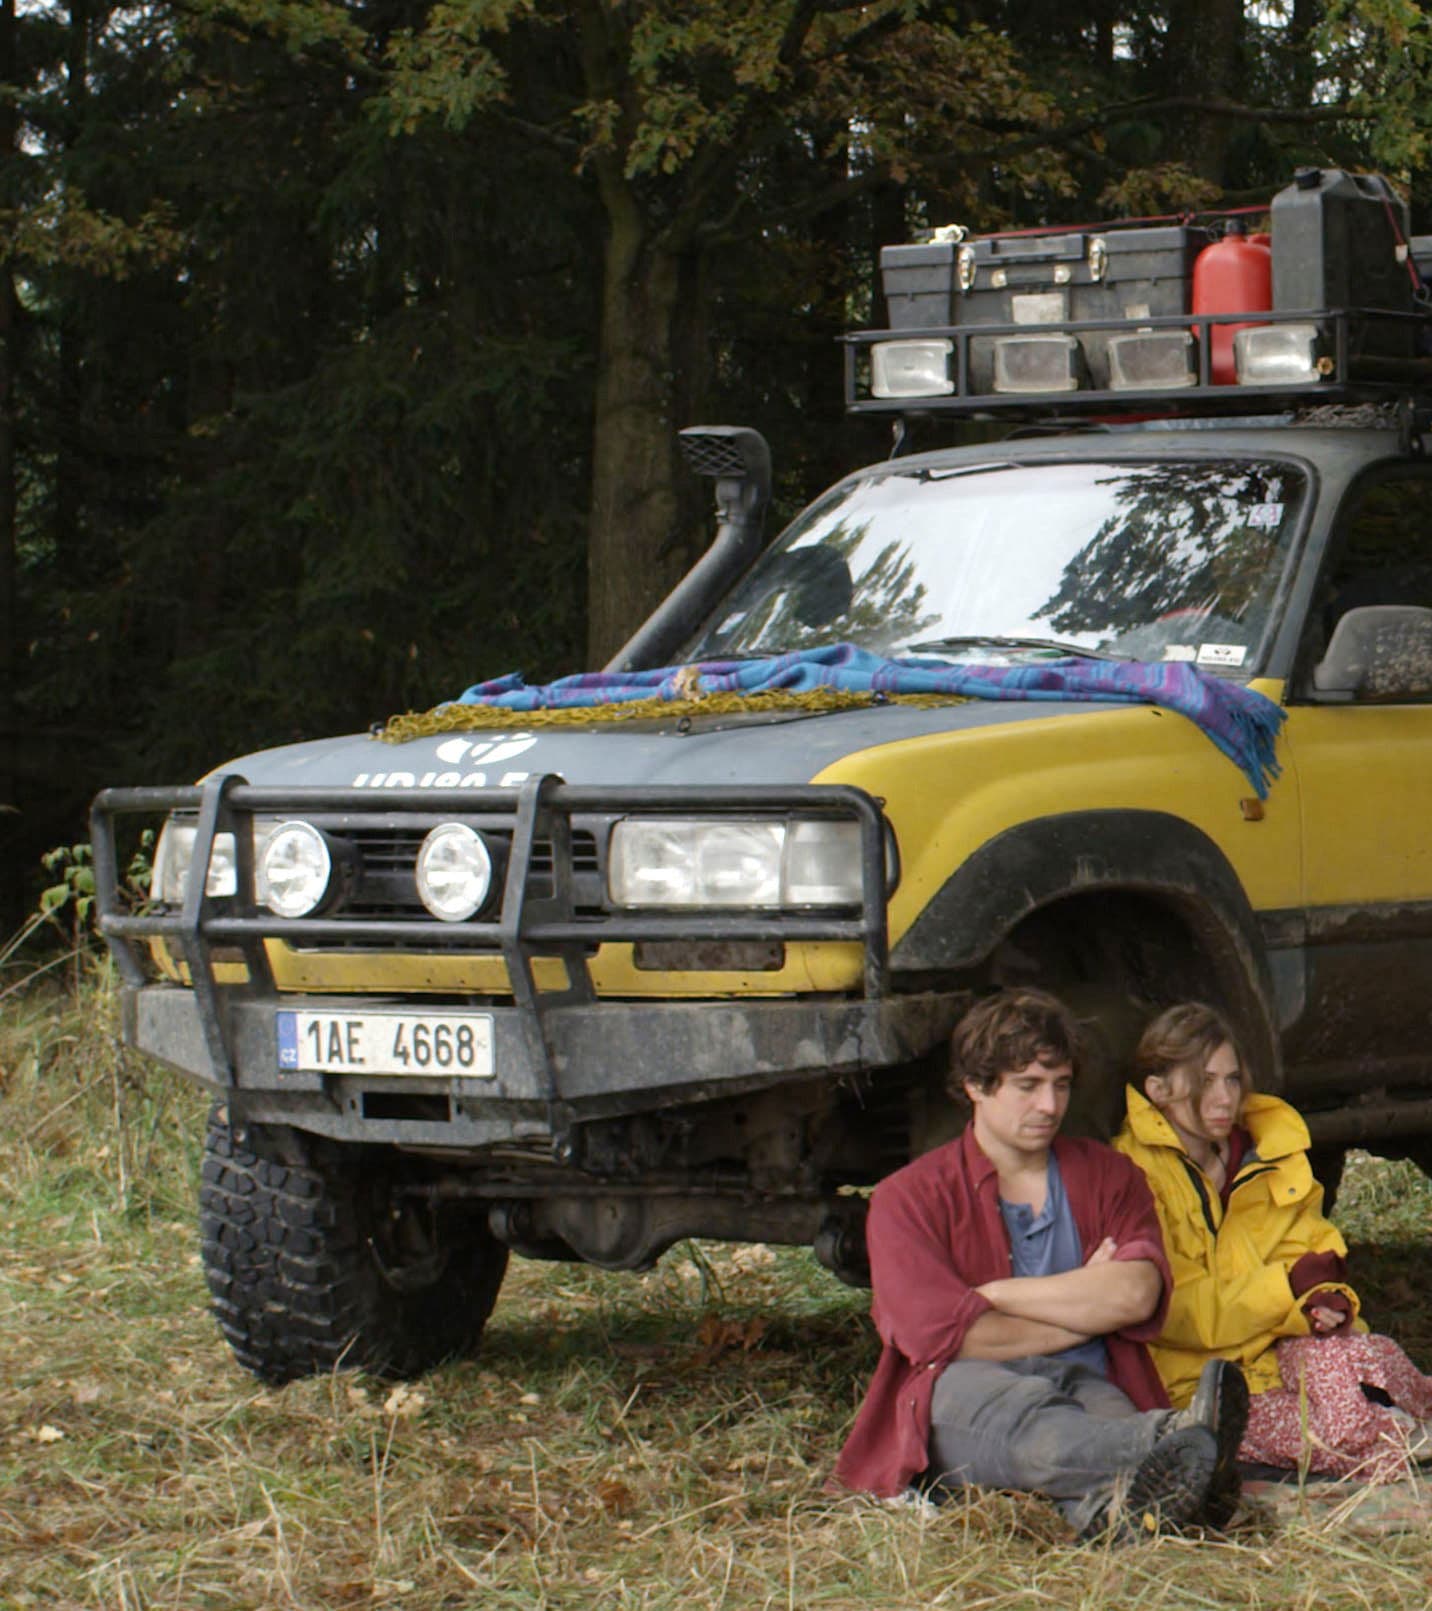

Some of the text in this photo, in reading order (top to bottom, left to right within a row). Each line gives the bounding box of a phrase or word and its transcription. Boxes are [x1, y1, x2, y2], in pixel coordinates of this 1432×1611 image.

[281, 1048, 297, 1066] CZ
[308, 1020, 474, 1067] 1AE 4668
